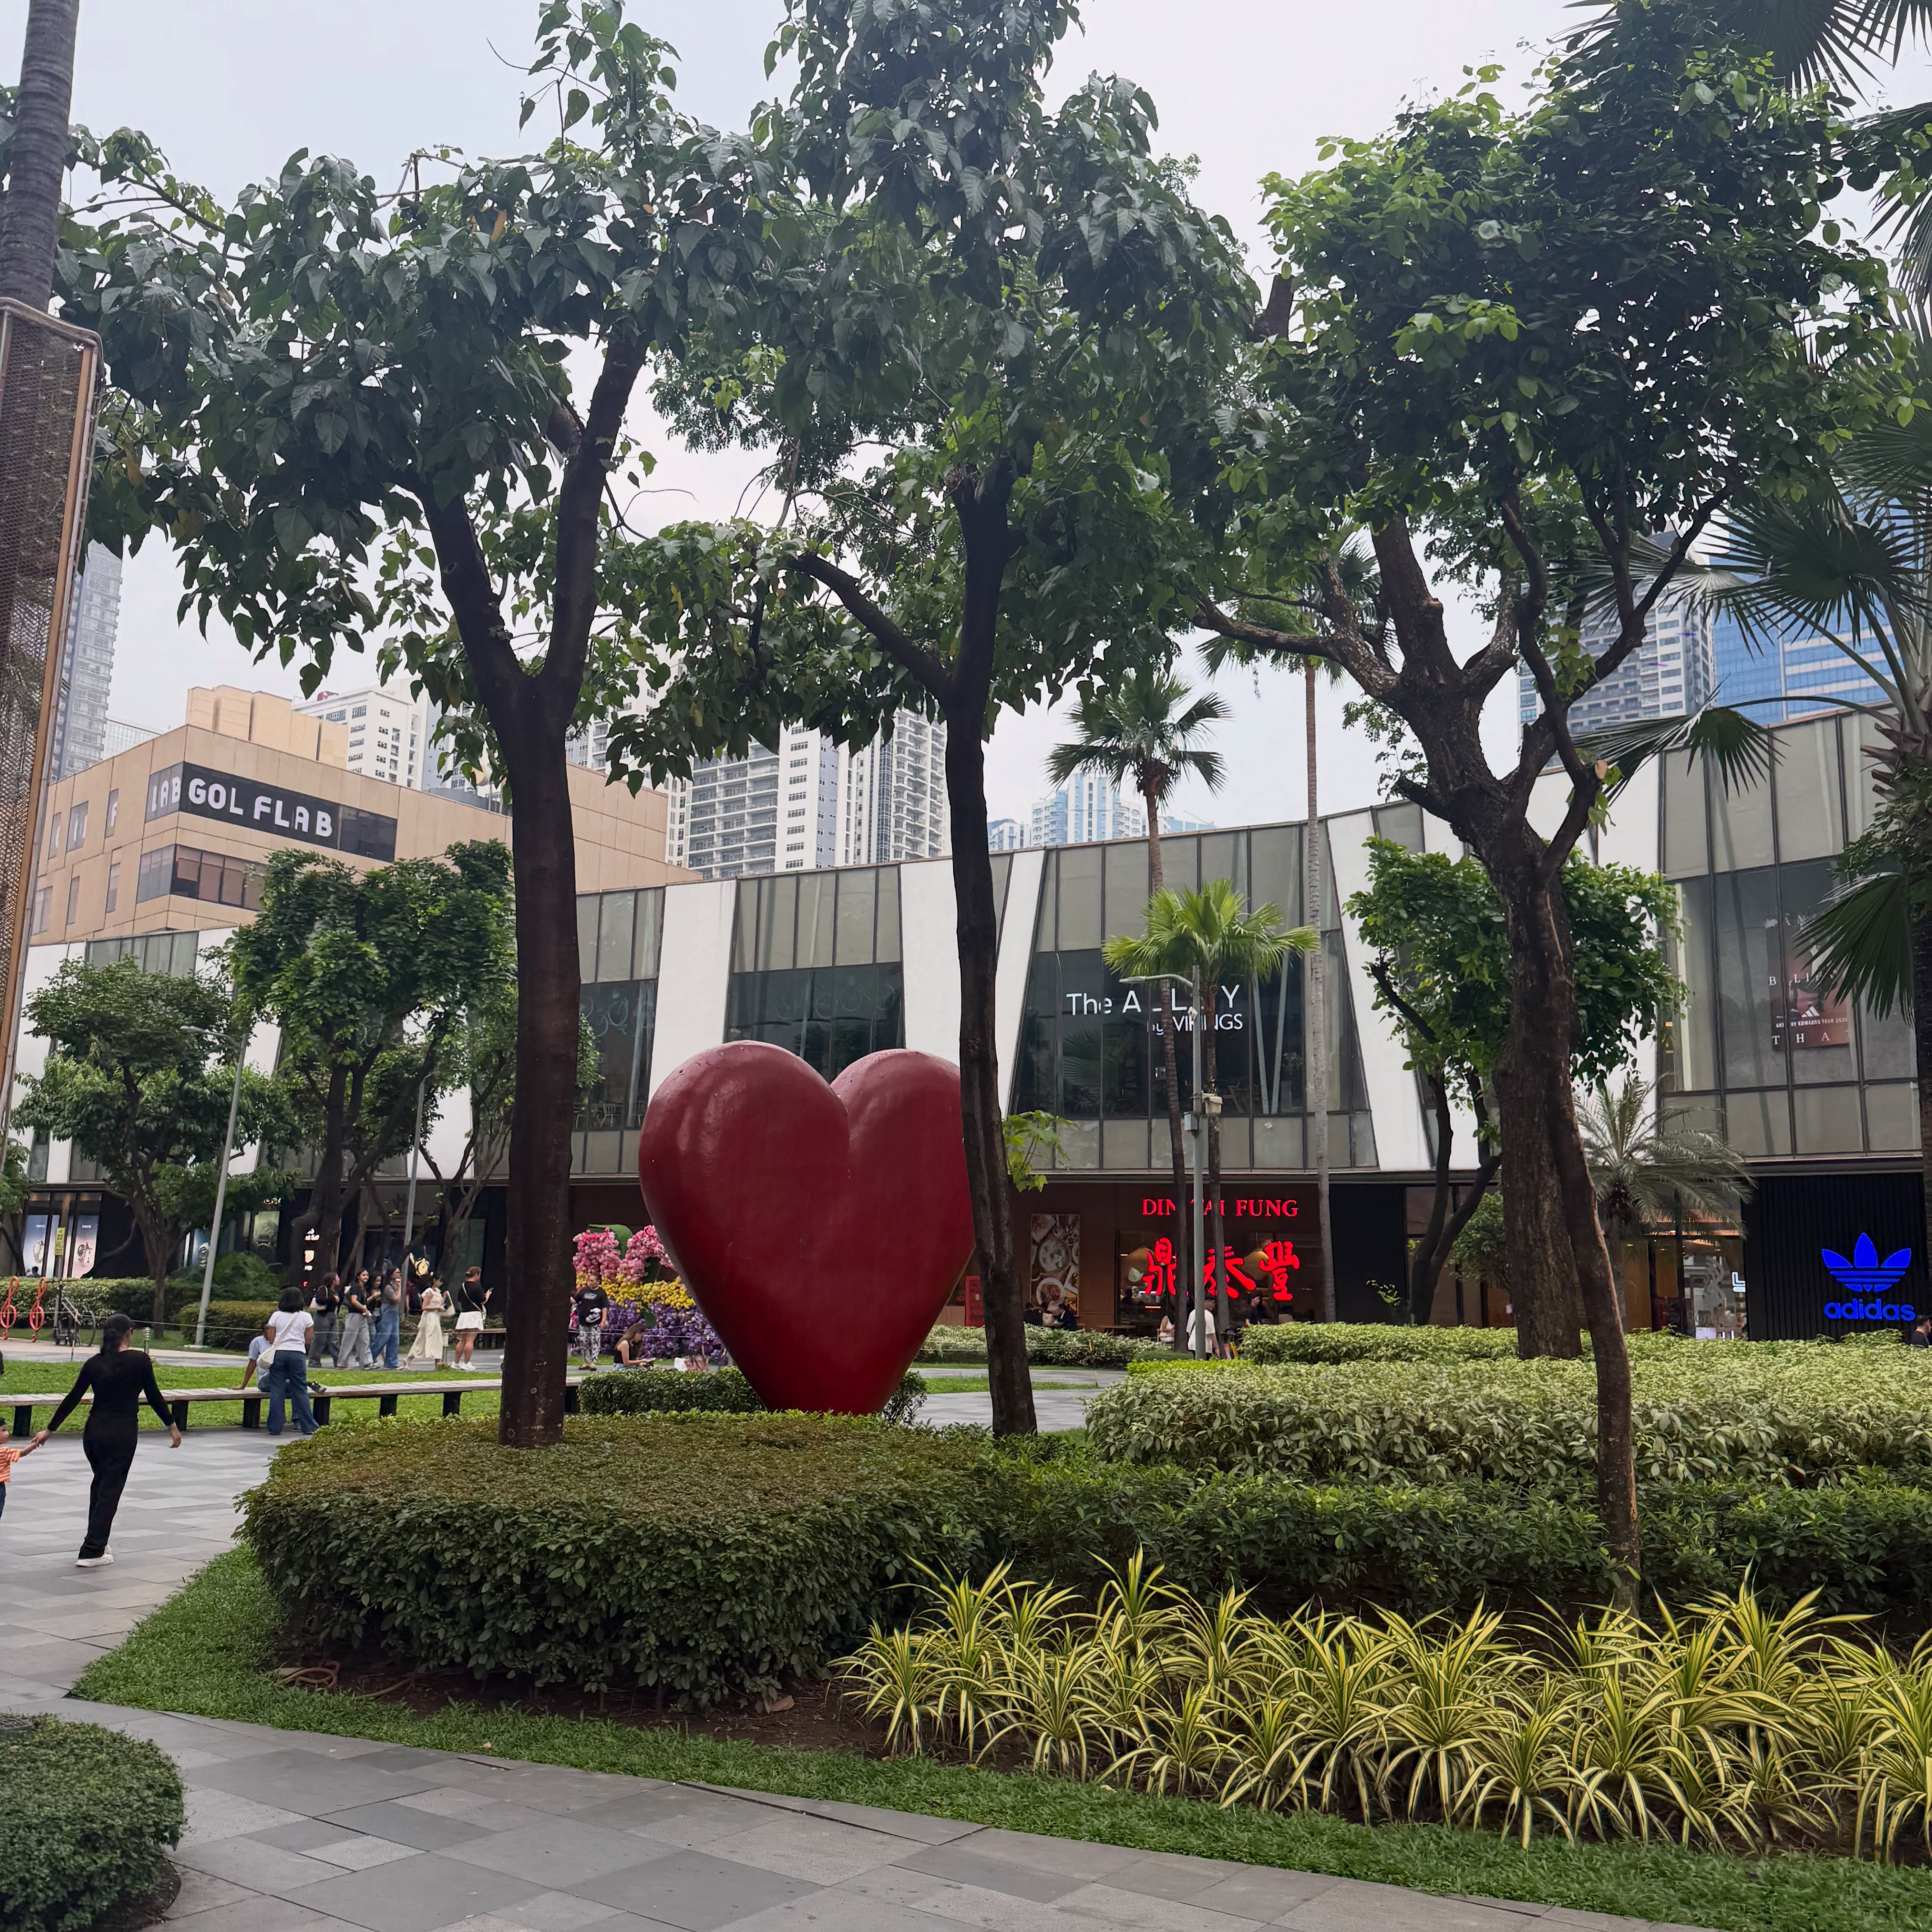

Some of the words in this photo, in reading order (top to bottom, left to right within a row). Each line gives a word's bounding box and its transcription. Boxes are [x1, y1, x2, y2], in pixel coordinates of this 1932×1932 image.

[1066, 993, 1112, 1016] The
[1122, 984, 1240, 1013] ALY
[1235, 1199, 1299, 1218] FUNG
[1824, 1298, 1916, 1321] adidas
